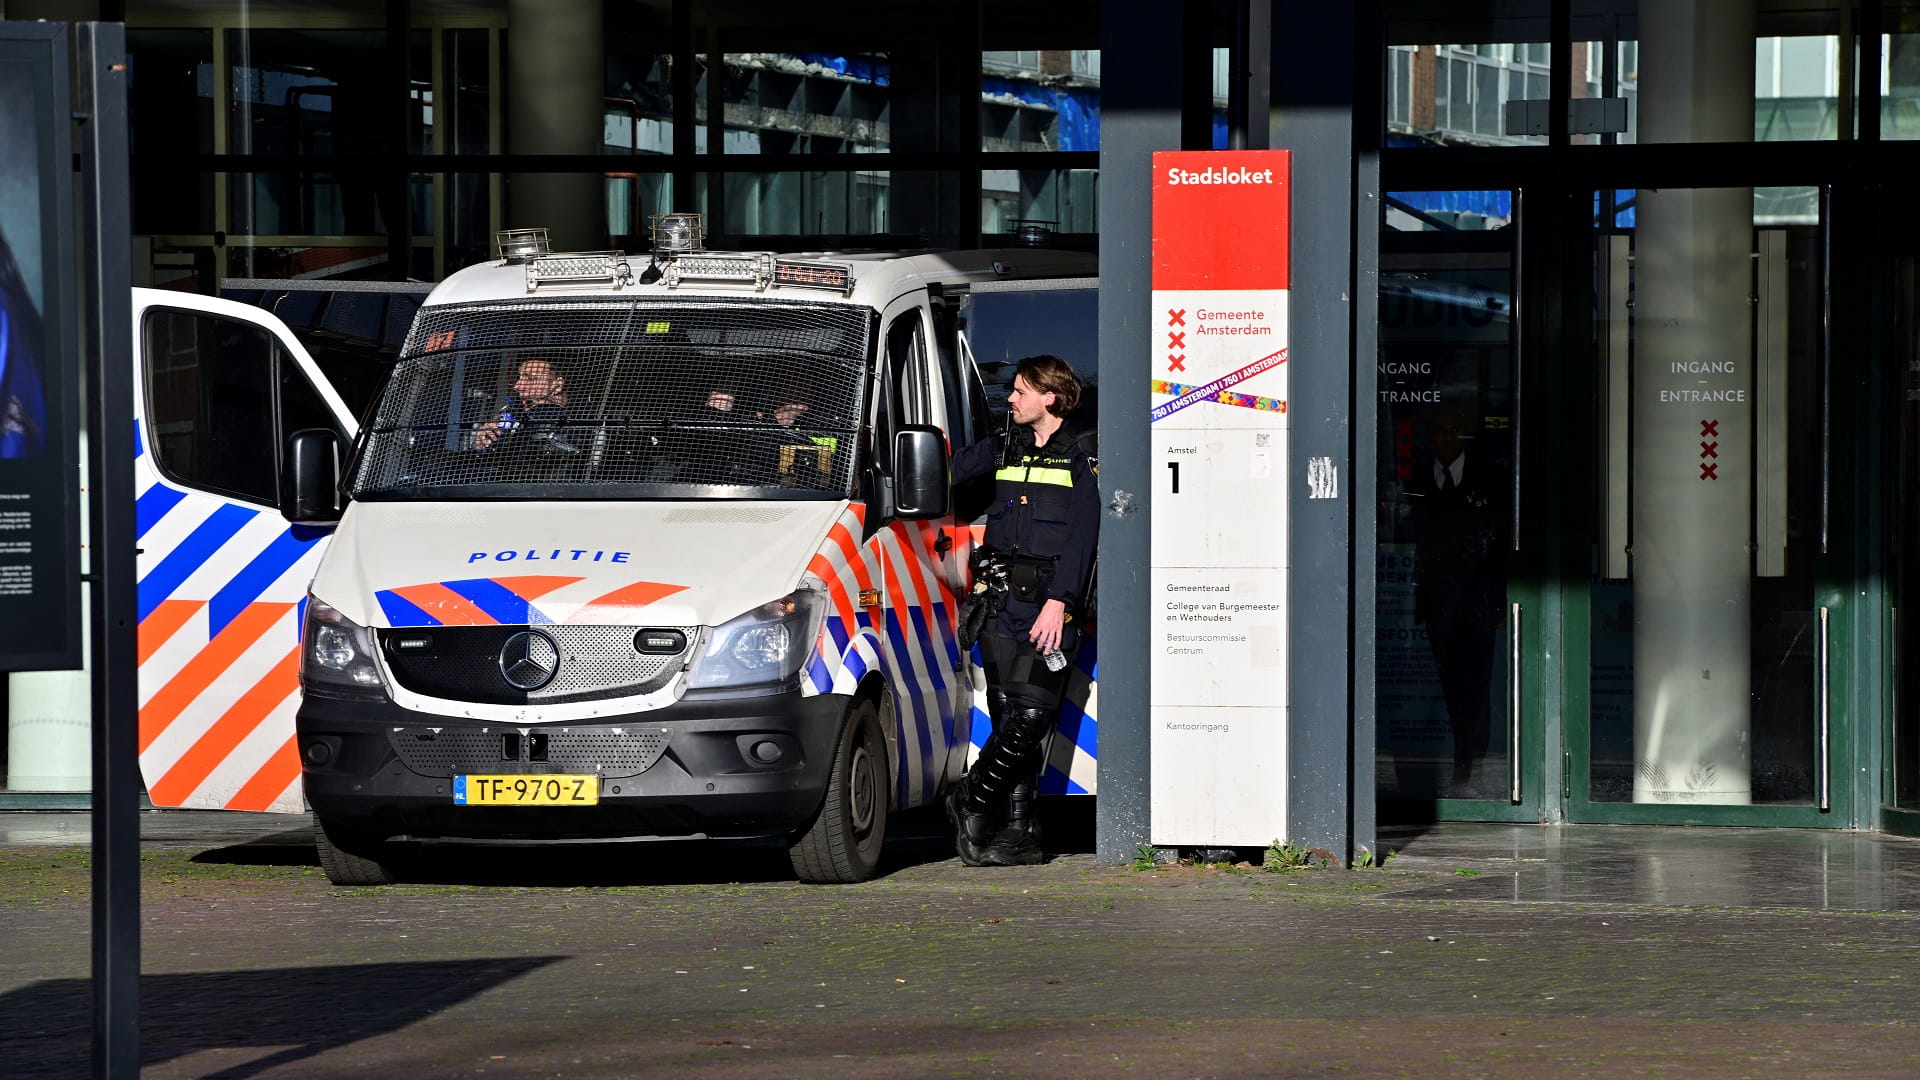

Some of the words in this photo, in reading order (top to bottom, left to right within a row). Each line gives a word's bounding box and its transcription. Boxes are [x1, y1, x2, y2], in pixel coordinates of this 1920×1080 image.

[1167, 166, 1273, 185] Stadsloket
[1196, 308, 1265, 321] Gemeente
[1196, 323, 1271, 336] Amsterdam
[1671, 361, 1736, 374] INGANG
[1152, 407, 1167, 420] 750
[1172, 382, 1219, 411] AMSTERDAM
[1223, 374, 1239, 387] 750
[1380, 390, 1441, 403] TRANCE
[1660, 390, 1745, 403] ENTRANCE
[1167, 446, 1197, 455] Amstel
[1167, 462, 1180, 494] 1
[468, 549, 631, 564] POLITIE
[1166, 583, 1230, 592] Gemeenteraad
[1166, 602, 1200, 614] College
[1219, 602, 1280, 613] Burgemeester
[1166, 614, 1177, 622] en
[1179, 612, 1232, 622] Wethouders
[1166, 633, 1247, 643] Bestuurscommissie
[1166, 646, 1204, 656] Centrum
[1166, 722, 1229, 733] Kantooringang
[455, 792, 466, 801] NL
[475, 778, 586, 801] TF-970-Z
